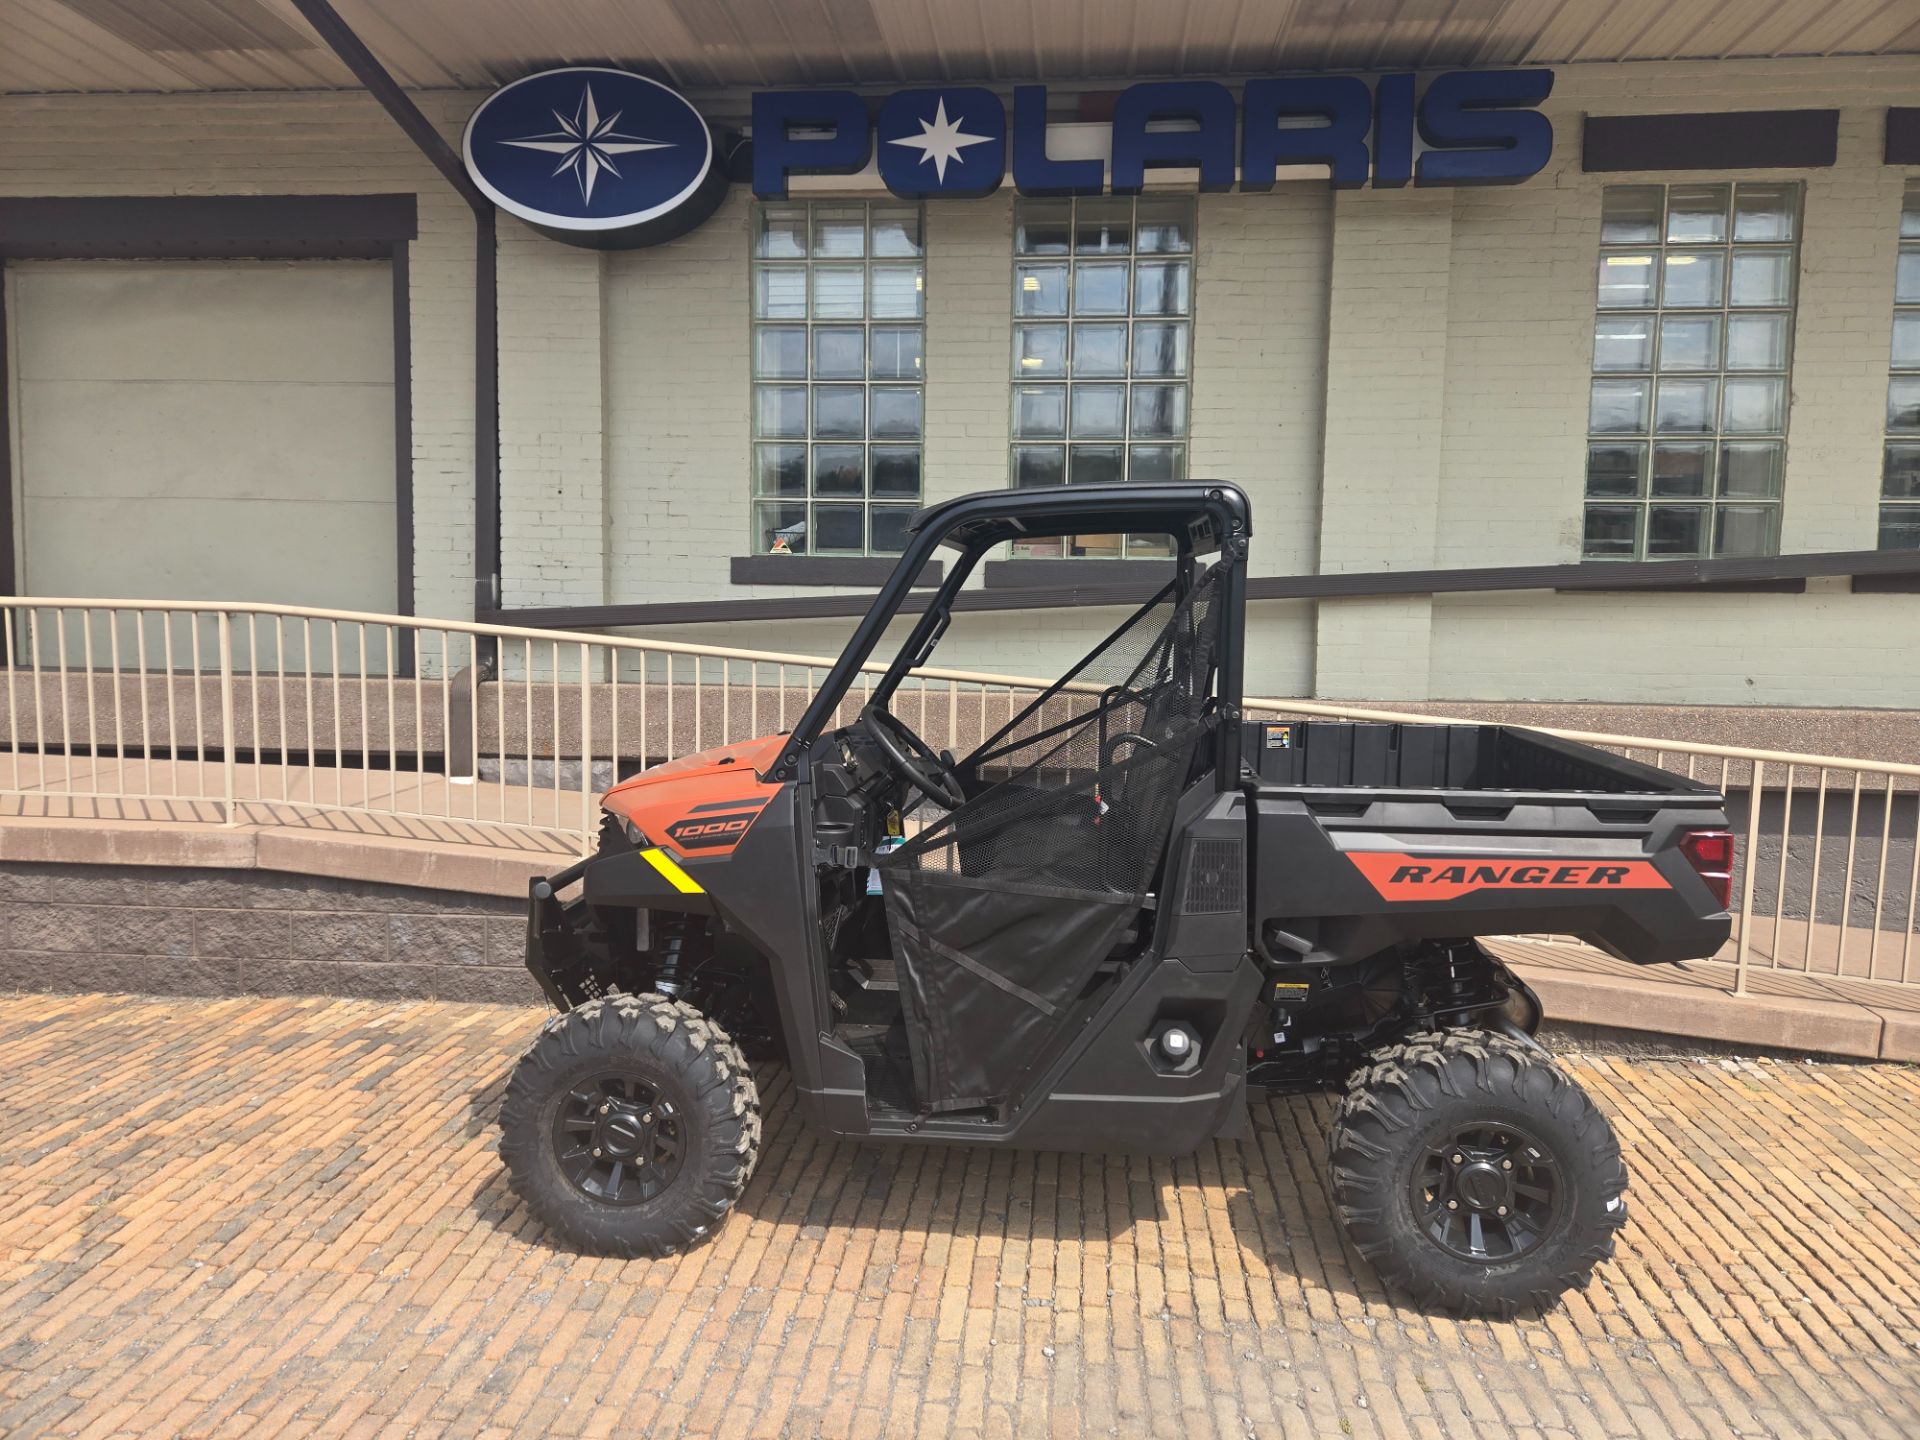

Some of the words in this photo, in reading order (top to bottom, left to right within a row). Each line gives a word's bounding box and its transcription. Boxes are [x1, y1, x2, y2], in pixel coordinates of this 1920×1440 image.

[752, 69, 1554, 200] POLARIS
[674, 819, 749, 838] 1000
[1388, 865, 1631, 885] RANGER
